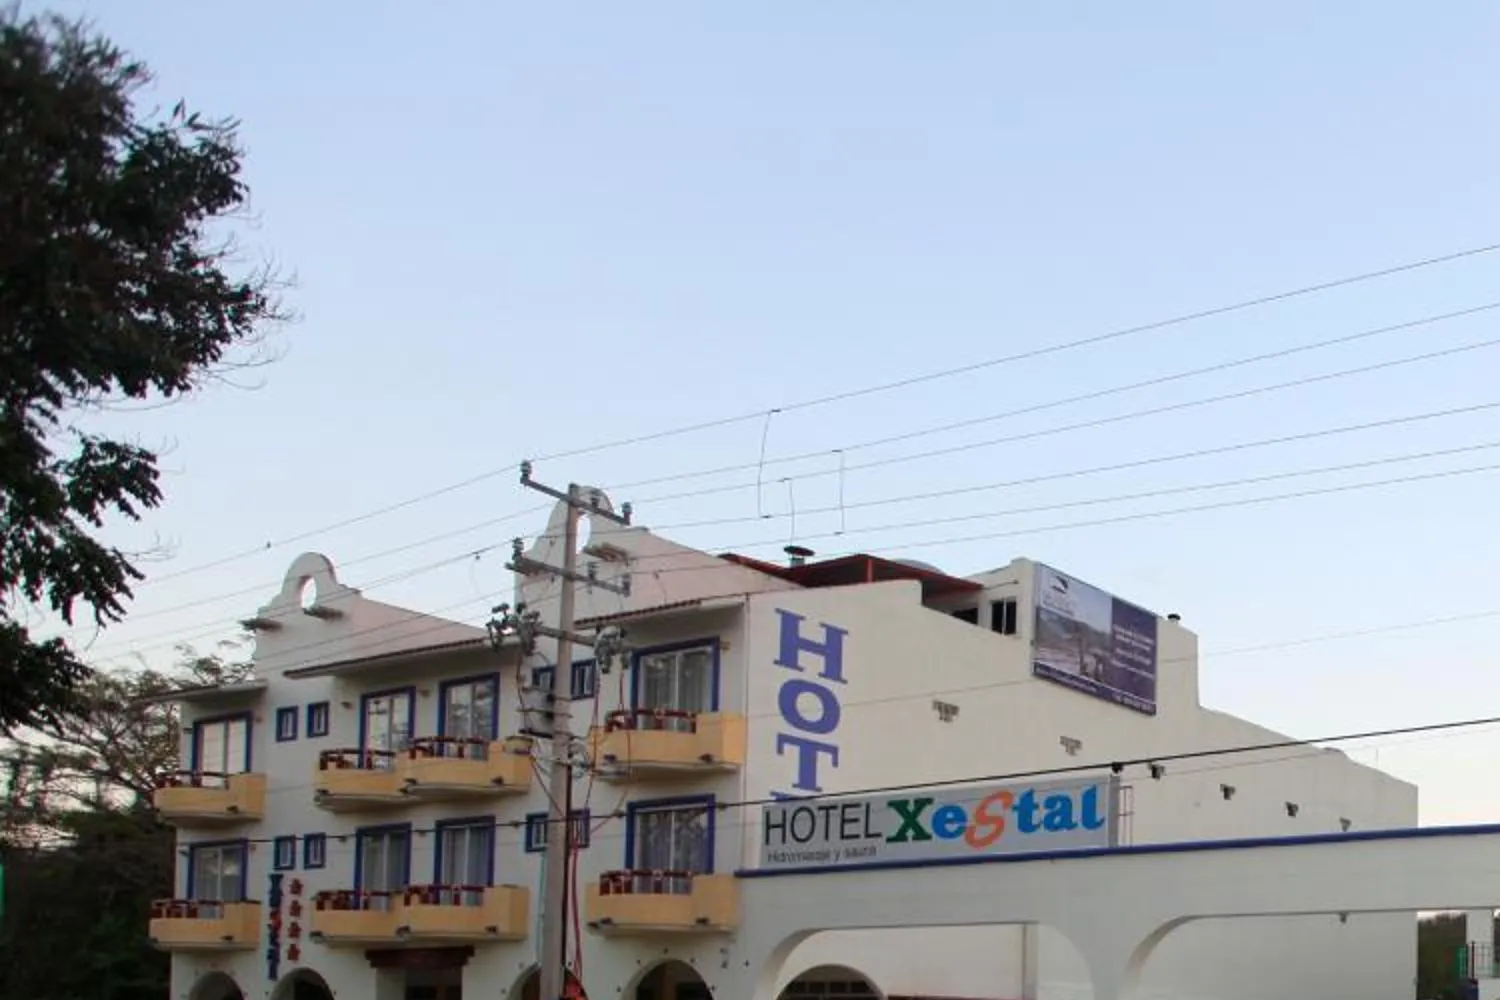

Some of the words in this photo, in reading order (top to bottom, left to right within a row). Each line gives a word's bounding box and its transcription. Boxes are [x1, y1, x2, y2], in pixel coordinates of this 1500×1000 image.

[773, 607, 849, 802] HOT
[765, 802, 882, 845] HOTEL
[885, 785, 1105, 848] XeStal
